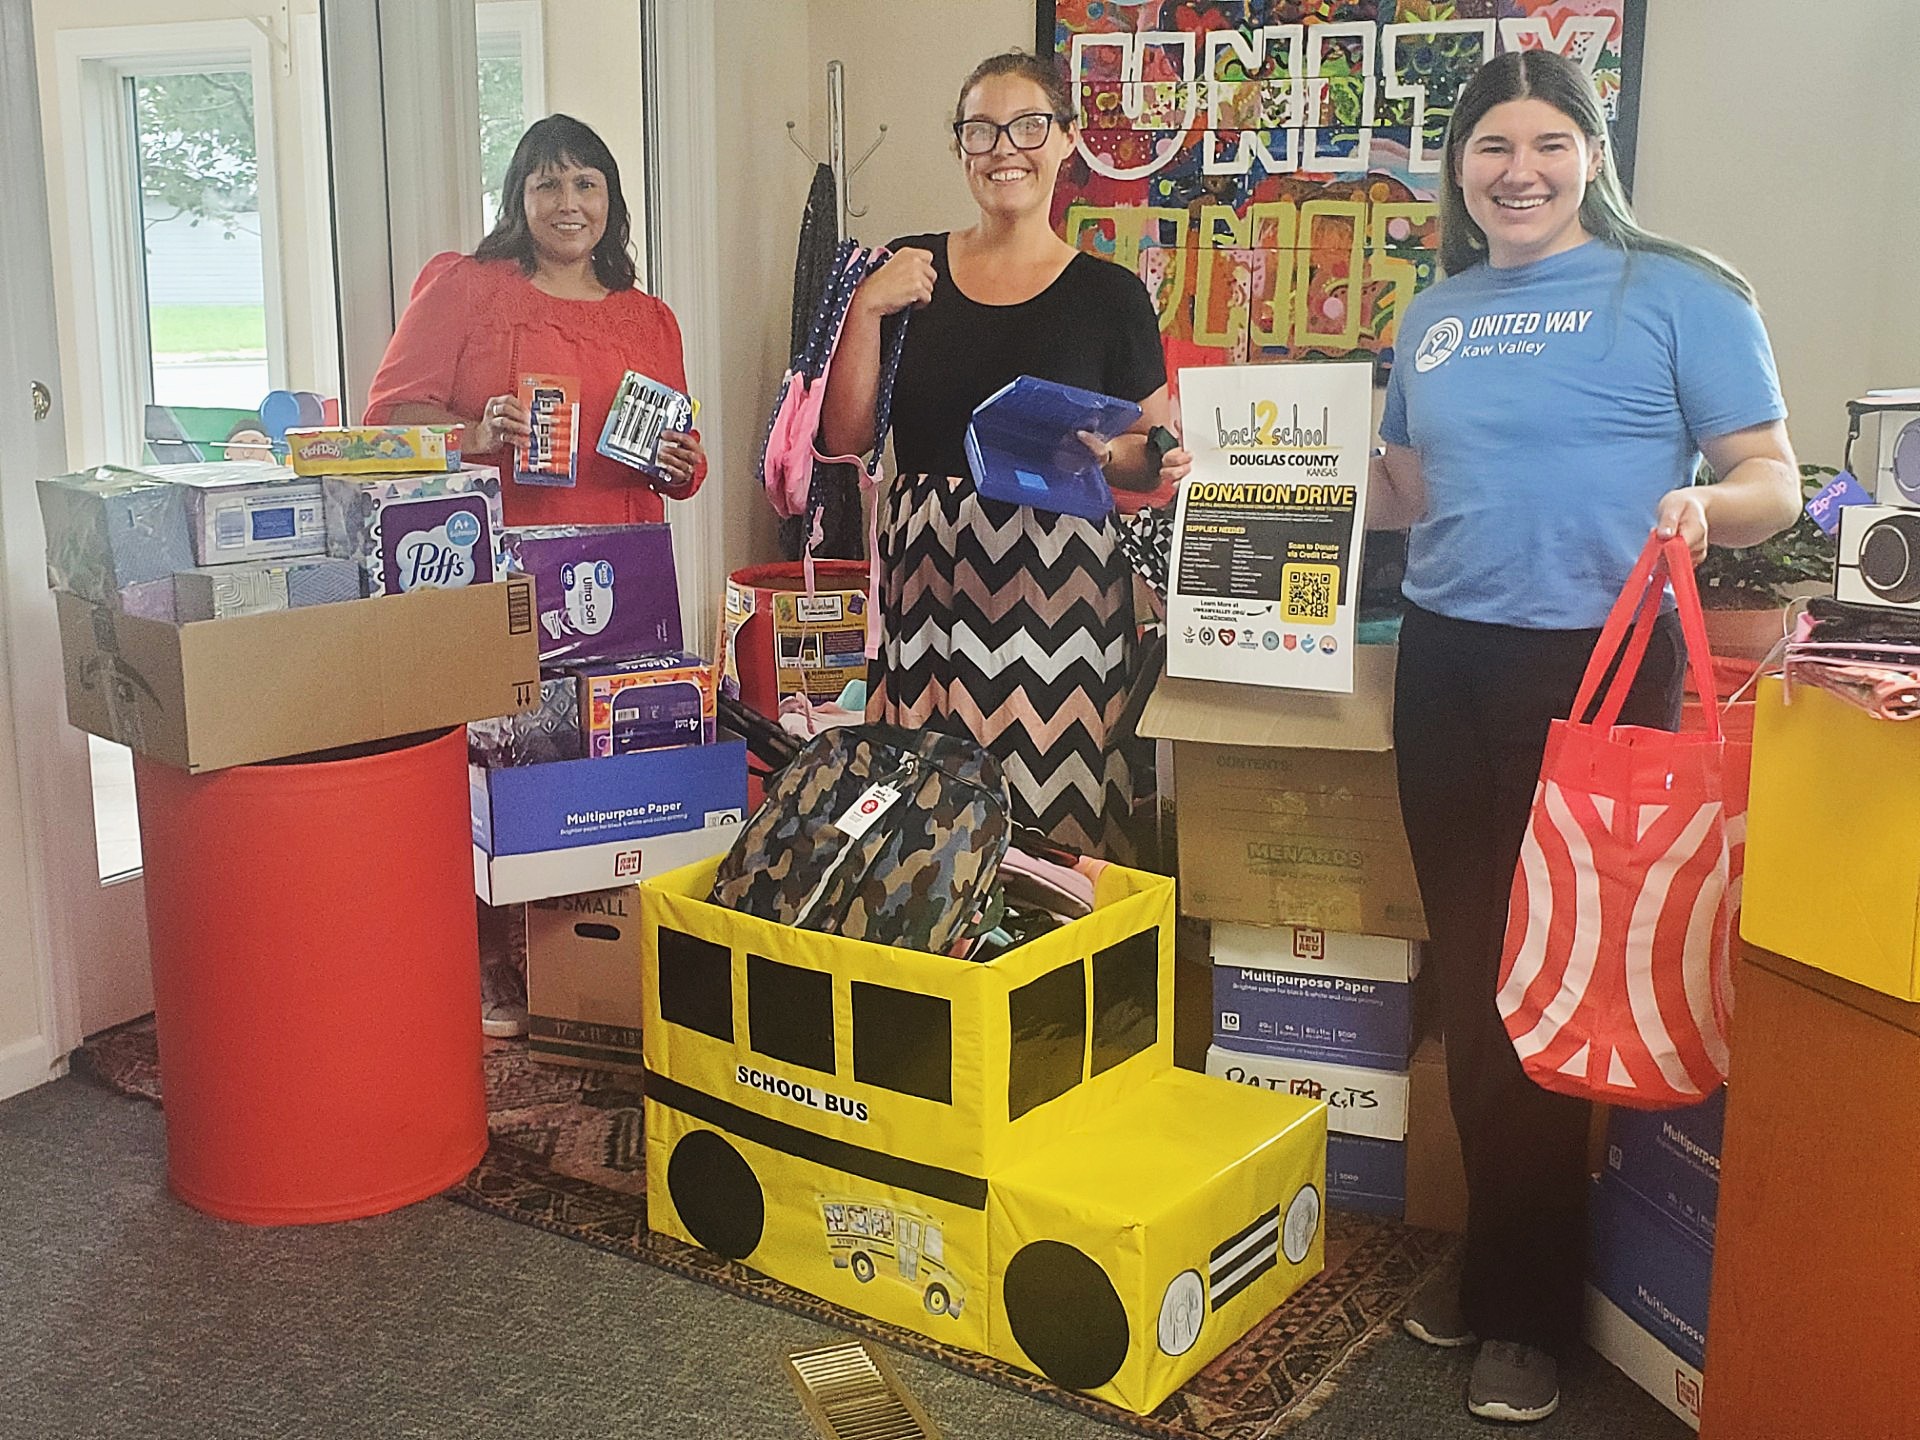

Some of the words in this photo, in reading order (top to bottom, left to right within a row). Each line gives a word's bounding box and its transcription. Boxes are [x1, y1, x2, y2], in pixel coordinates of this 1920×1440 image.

[1469, 313, 1541, 339] UNITED
[1545, 310, 1593, 333] WAY
[1460, 344, 1494, 358] Kaw
[1498, 340, 1546, 356] Valley
[1230, 454, 1286, 466] DOUGLAS
[1288, 455, 1339, 467] COUNTY
[1306, 468, 1338, 478] KANSAS
[1189, 482, 1290, 504] DONATION
[1294, 485, 1355, 506] DRIVE
[1808, 481, 1847, 517] Zip-Up
[454, 519, 469, 530] A+
[1185, 525, 1218, 534] SUPPLIES
[1288, 542, 1305, 550] Scan
[1315, 543, 1339, 551] Donate
[1299, 551, 1320, 559] Credit
[1321, 552, 1338, 560] Card
[407, 542, 464, 587] Puffs
[583, 577, 592, 602] Ultra
[586, 604, 597, 625] Soft
[567, 807, 646, 826] Multipurpose
[648, 801, 682, 815] Paper
[563, 896, 628, 917] SMALL
[1299, 935, 1319, 944] TRU
[1299, 943, 1319, 952] RED
[1241, 969, 1331, 989] Multipurpose
[1335, 979, 1376, 994] Paper
[1223, 1015, 1238, 1025] 10
[738, 1065, 817, 1107] SCHOOL
[825, 1093, 868, 1121] BUS
[1663, 1121, 1721, 1170] Multipurpos
[1637, 1284, 1705, 1345] Multipurpose
